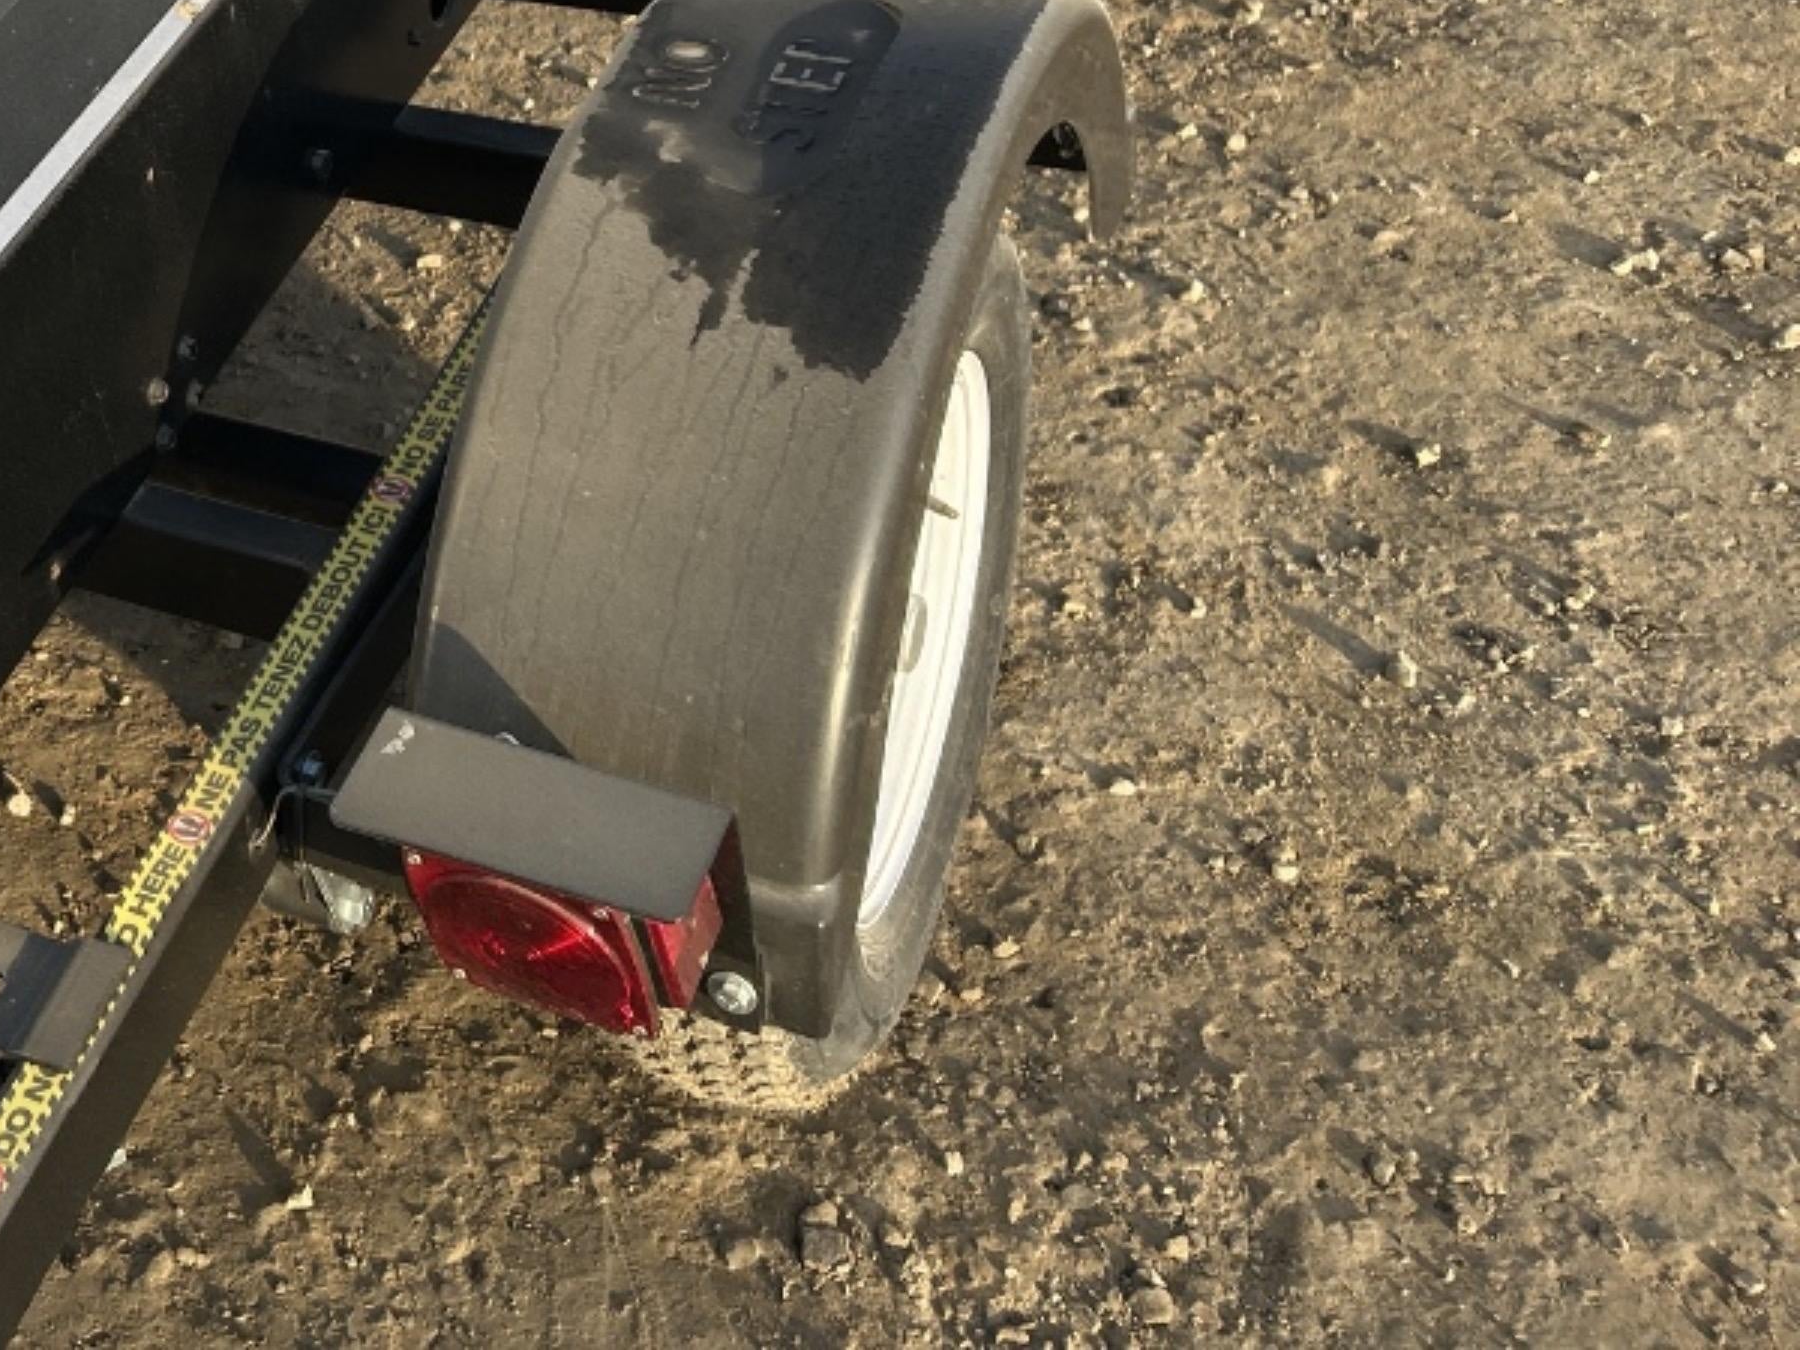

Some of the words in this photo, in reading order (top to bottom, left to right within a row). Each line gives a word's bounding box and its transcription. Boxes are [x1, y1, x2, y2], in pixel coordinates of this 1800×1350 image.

[197, 767, 234, 812] NE
[226, 716, 263, 770] PAS
[250, 637, 312, 713] TENEZ
[300, 537, 368, 634] DEBOUT
[359, 503, 390, 540] ICI
[124, 843, 185, 918] HERE
